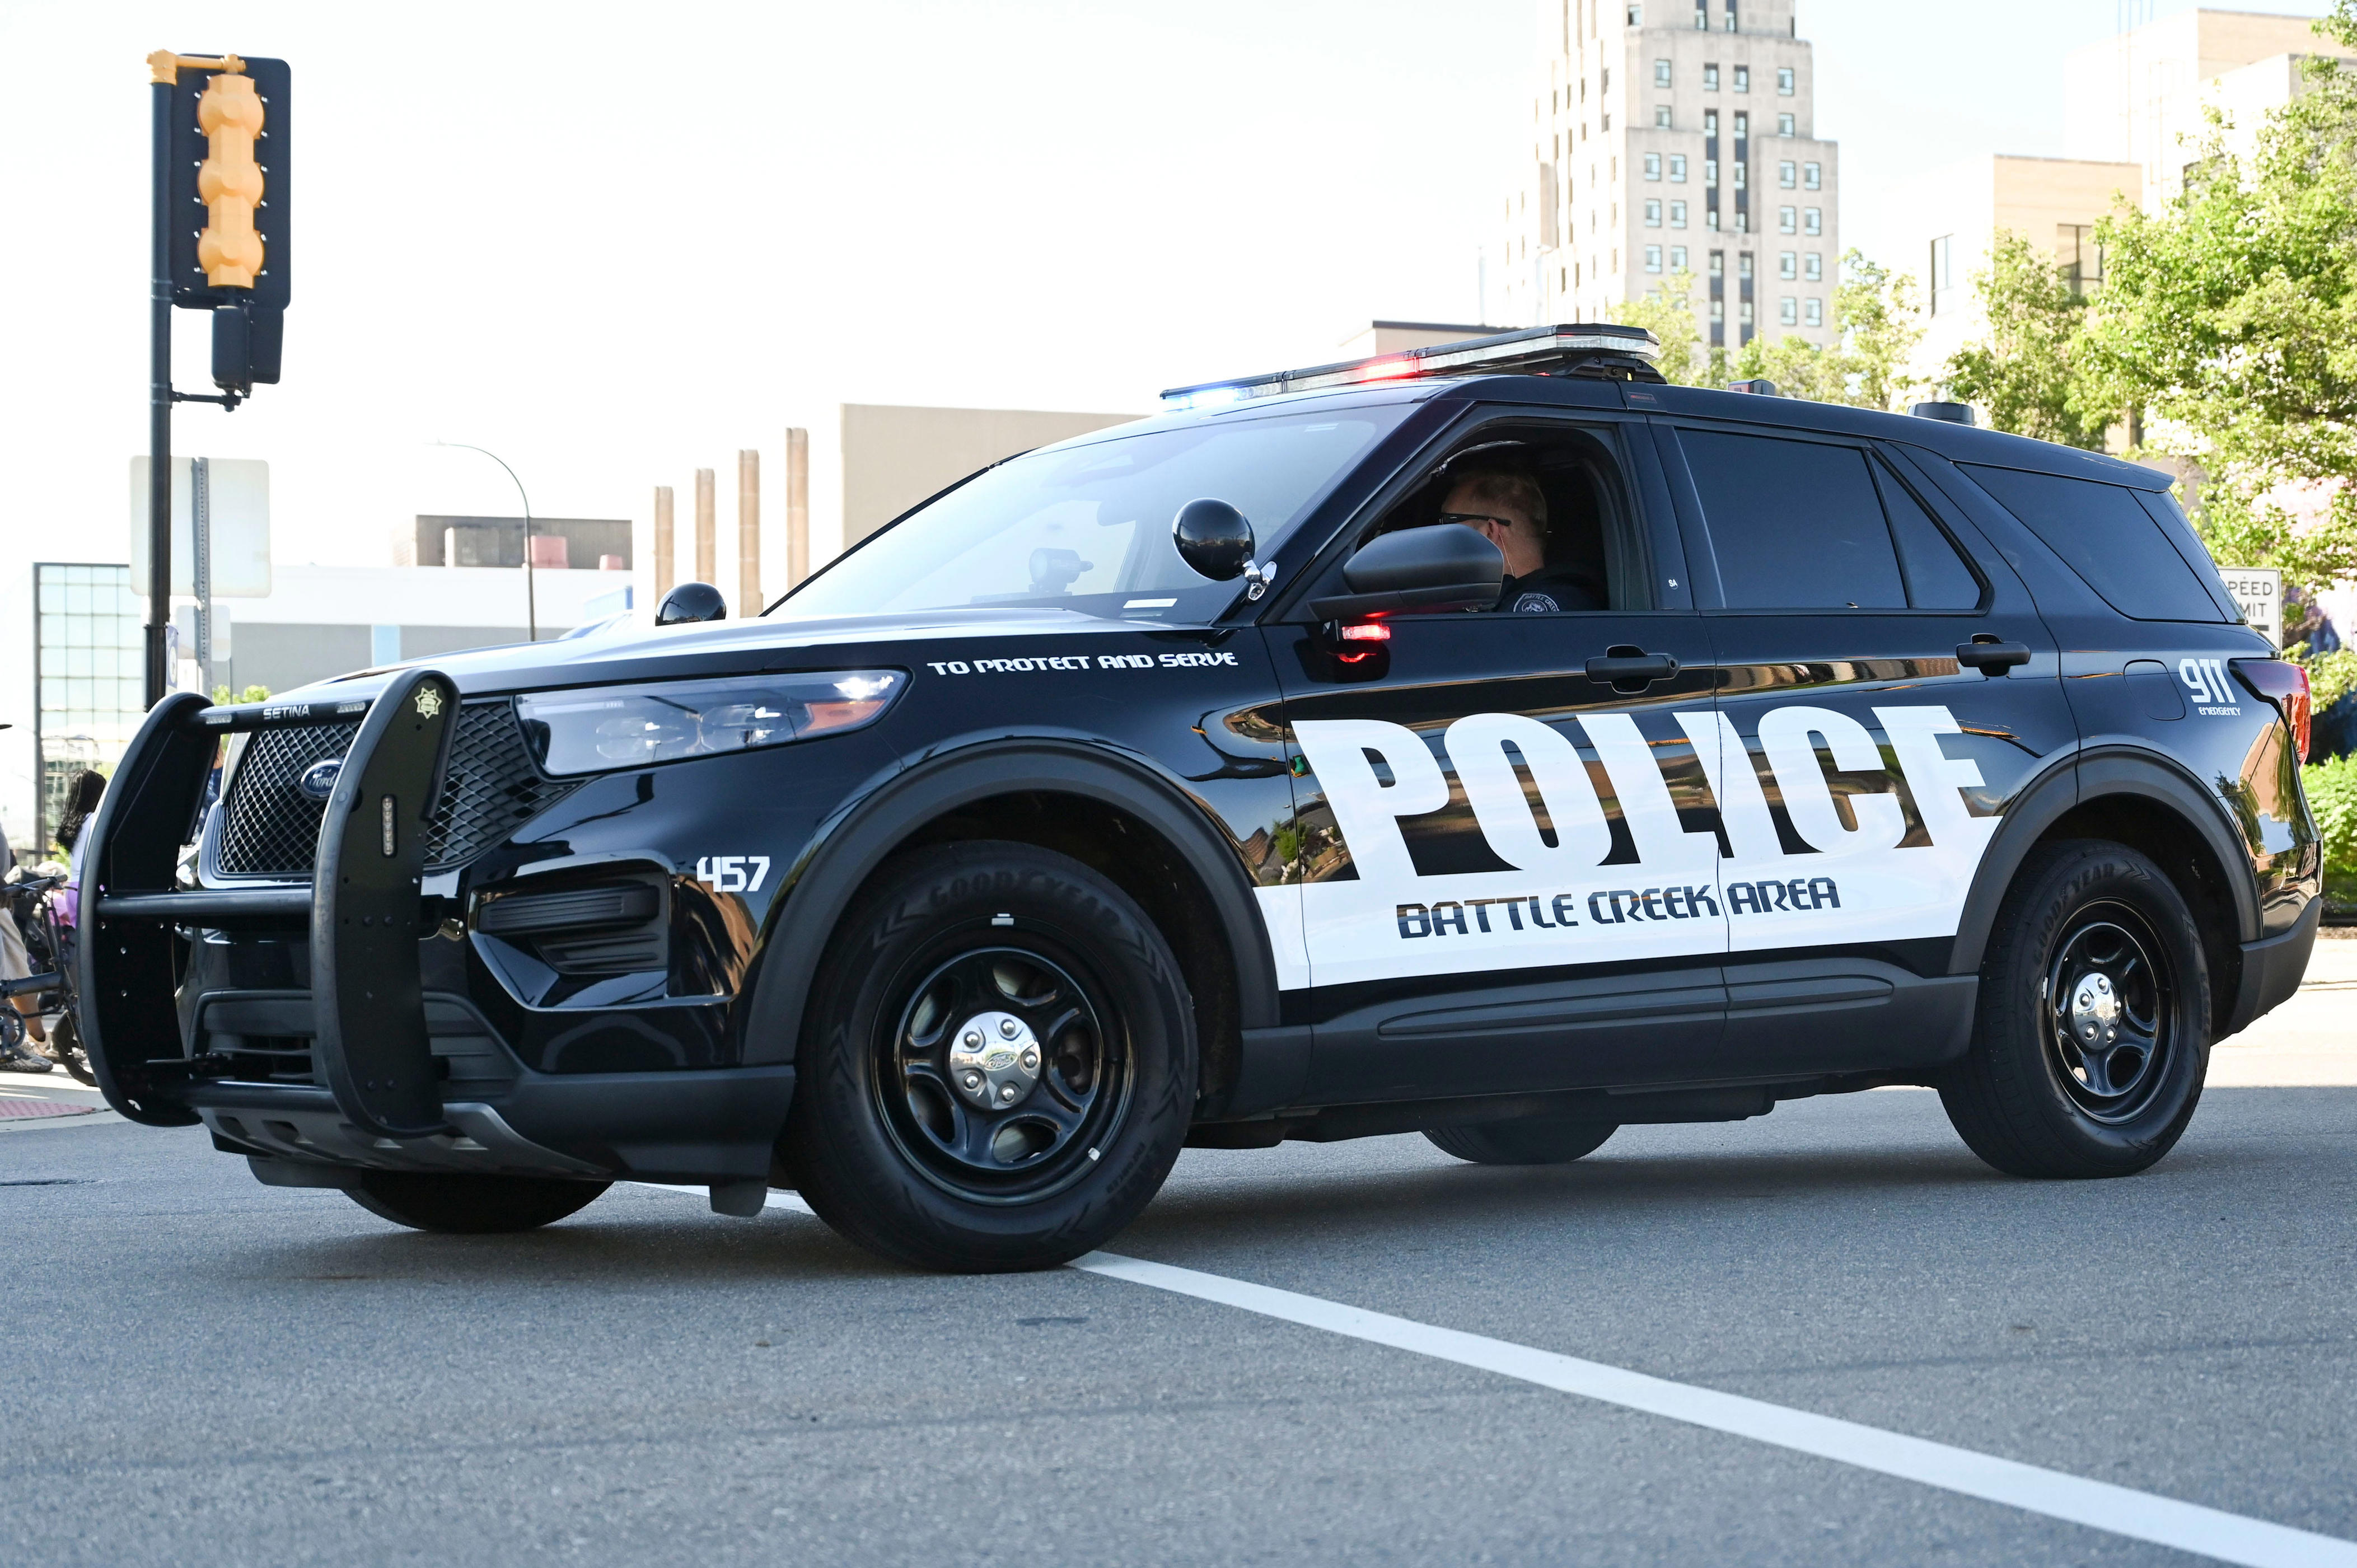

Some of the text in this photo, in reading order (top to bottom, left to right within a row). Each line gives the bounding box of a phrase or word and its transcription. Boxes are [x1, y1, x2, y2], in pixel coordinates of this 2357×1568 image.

[2228, 581, 2273, 596] PEED
[2239, 602, 2267, 617] MIT
[927, 652, 1239, 676] TO PROTECT AND SERVE
[2178, 658, 2237, 703] 911
[263, 705, 310, 720] SETINA
[2198, 706, 2241, 716] EMERGENCY
[309, 768, 338, 788] Ford
[1289, 705, 2004, 882] POLICE
[696, 856, 771, 892] 457
[1395, 877, 1842, 939] BATTLE CREEK AREA
